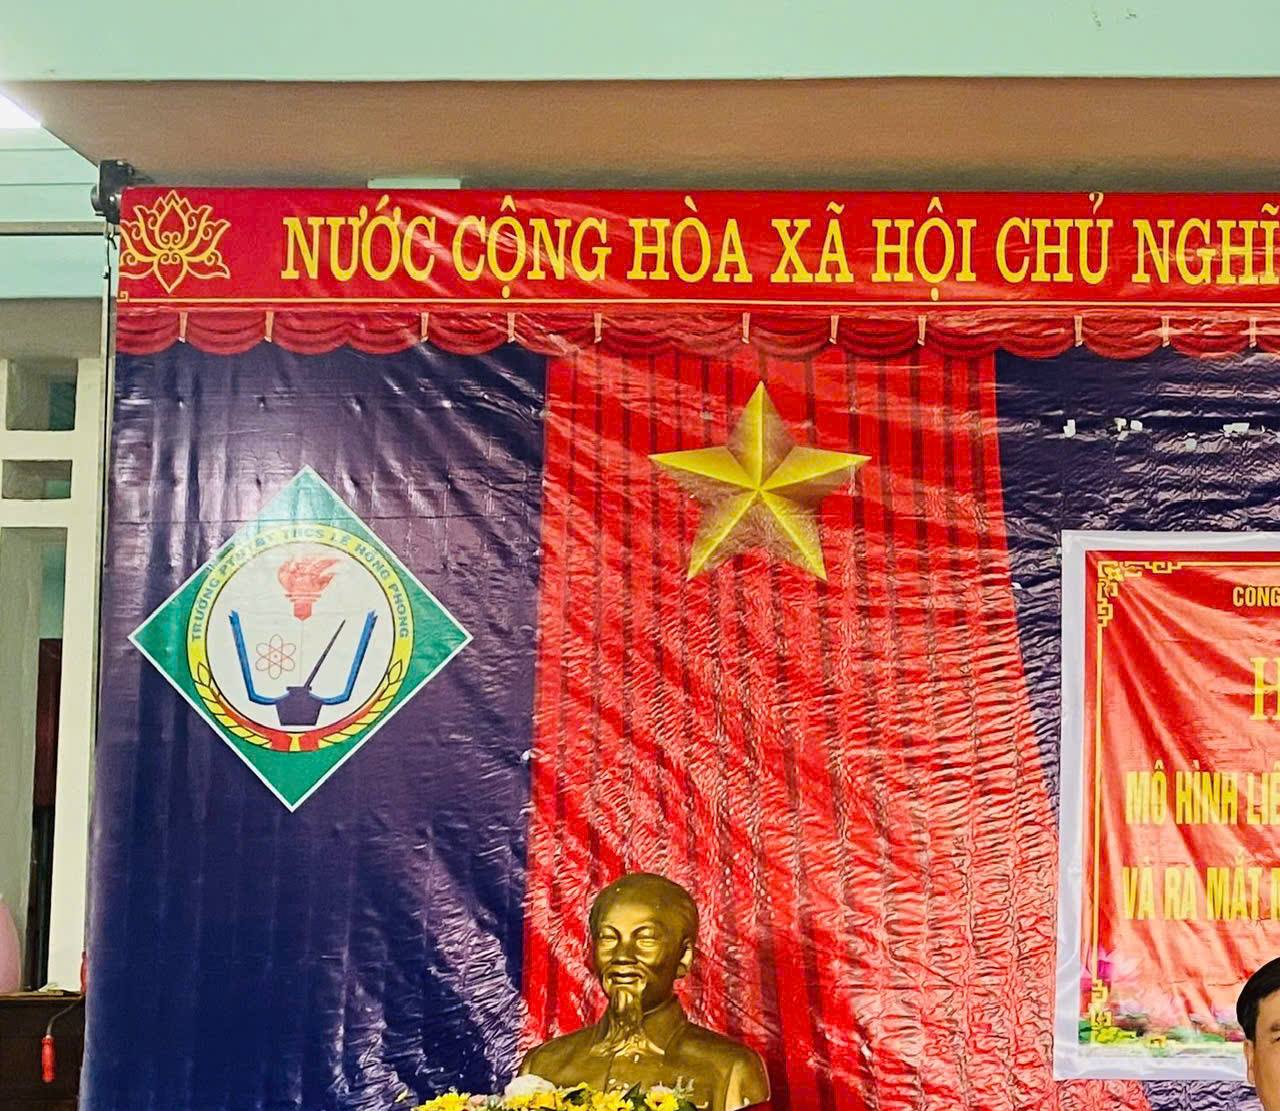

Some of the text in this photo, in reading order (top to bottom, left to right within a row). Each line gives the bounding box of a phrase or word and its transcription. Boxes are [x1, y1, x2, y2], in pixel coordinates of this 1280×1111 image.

[281, 195, 435, 283] NƯỚC
[452, 194, 612, 299] CỘNG
[626, 195, 753, 283] HÒA
[769, 202, 855, 284] XÃ
[870, 196, 979, 301] HỘI
[996, 191, 1110, 286] CHỦ
[388, 583, 410, 638] PHONG
[1125, 759, 1168, 825] MÔ
[1175, 759, 1239, 825] HÌNH
[1163, 866, 1199, 921] RA
